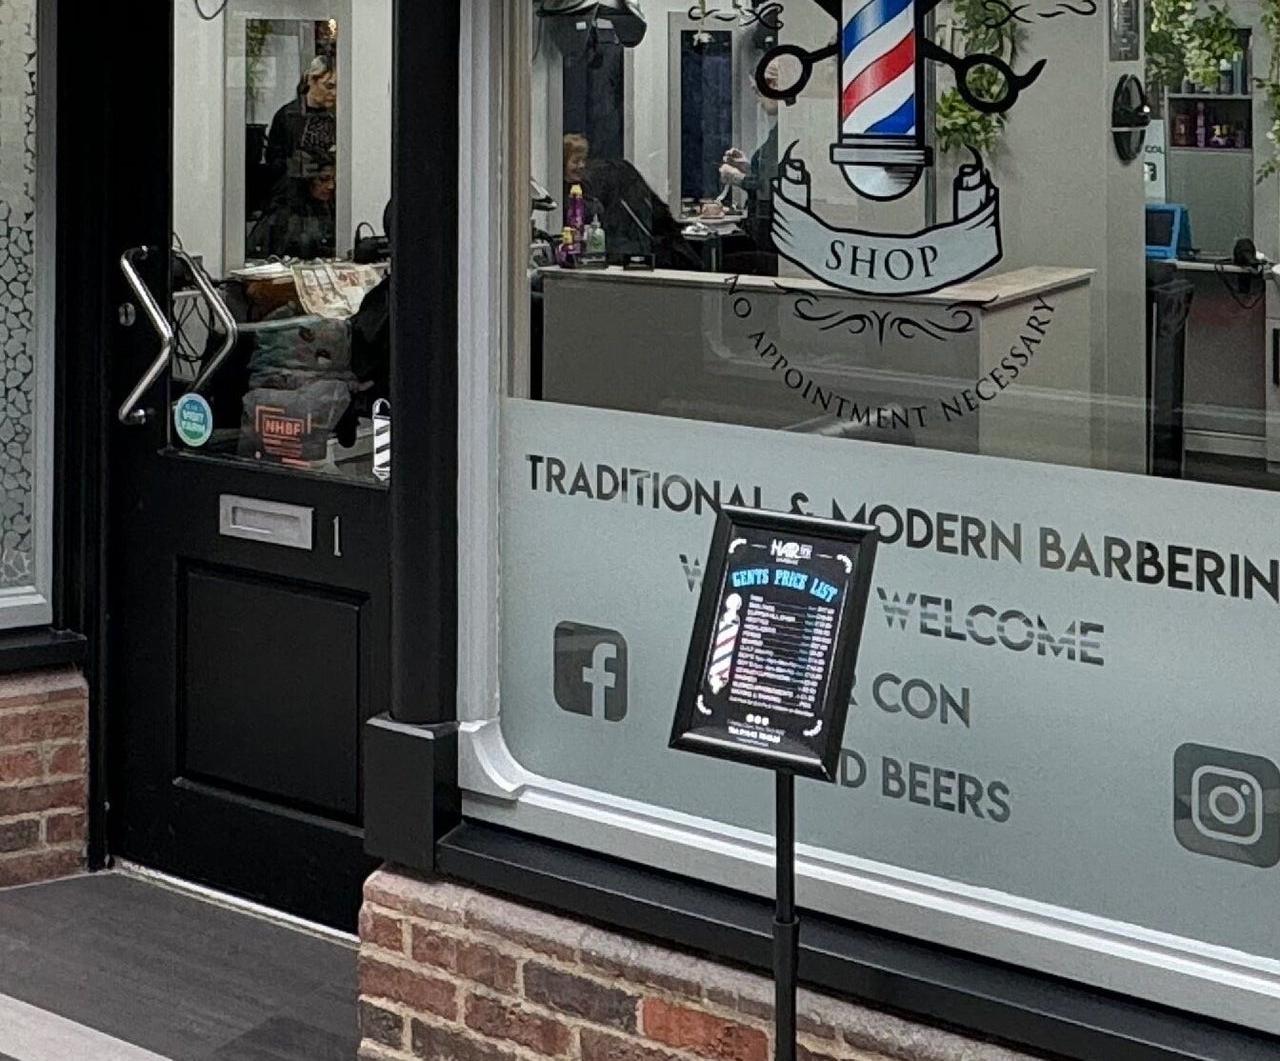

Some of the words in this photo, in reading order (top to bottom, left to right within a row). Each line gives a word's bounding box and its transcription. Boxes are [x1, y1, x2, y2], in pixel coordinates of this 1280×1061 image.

[825, 240, 938, 280] SHOP
[724, 275, 752, 319] NO
[748, 331, 928, 429] APPOINTMENT
[940, 295, 1055, 422] NECESSARY
[831, 497, 1022, 563] MODERN
[877, 586, 1105, 667] WELCOME
[872, 672, 970, 729] CON
[882, 756, 1011, 823] BEERS
